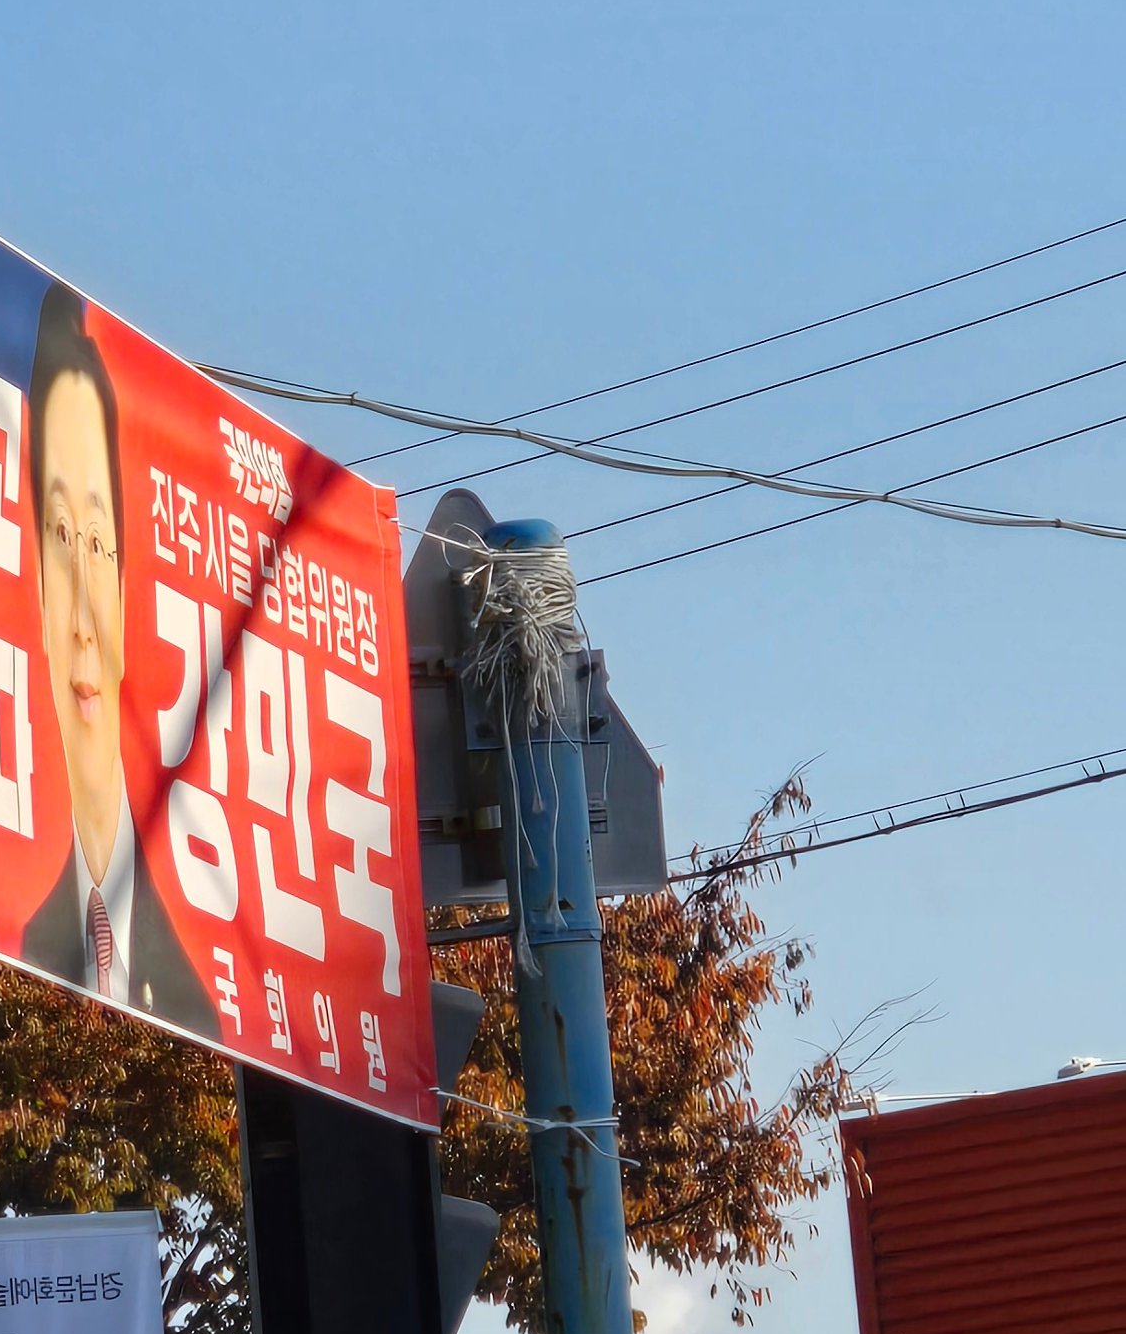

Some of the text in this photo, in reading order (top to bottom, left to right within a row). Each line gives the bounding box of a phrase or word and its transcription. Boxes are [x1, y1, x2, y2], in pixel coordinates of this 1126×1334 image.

[149, 466, 379, 678] 진주시을 당협위원장
[219, 416, 294, 526] 국민의힘
[154, 579, 401, 997] 강민국
